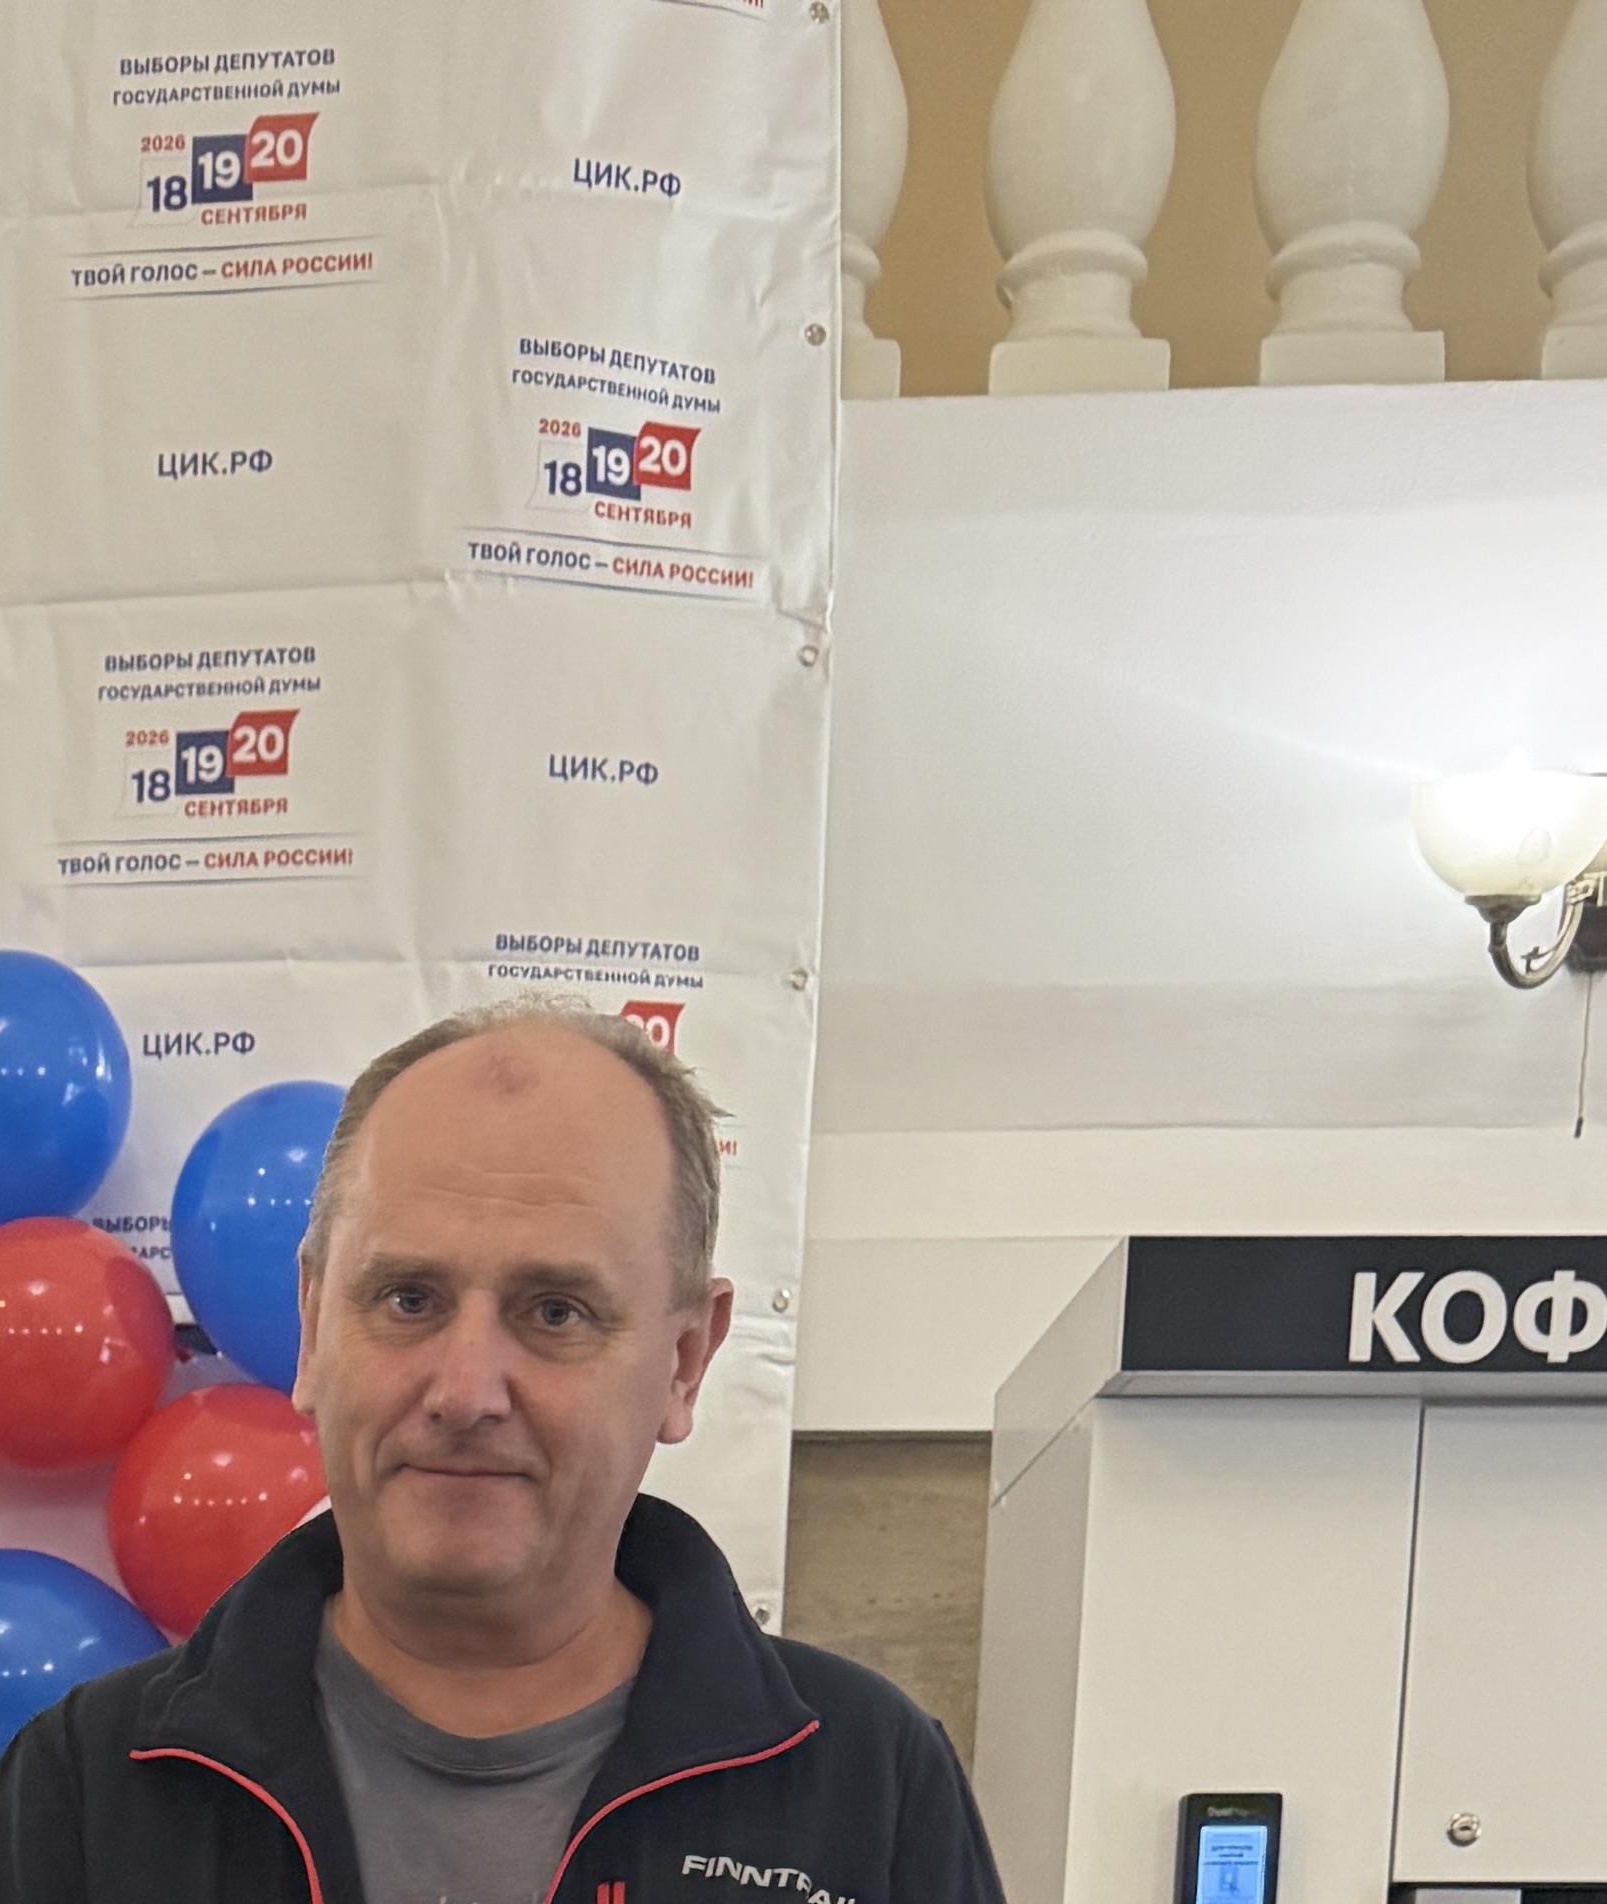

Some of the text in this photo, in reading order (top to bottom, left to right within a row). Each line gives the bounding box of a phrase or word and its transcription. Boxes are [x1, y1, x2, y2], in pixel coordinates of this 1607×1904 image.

[121, 49, 335, 75] ВЫБОРЫ ДЕПУТАТОВ
[113, 80, 340, 105] ГОСУДАРСТВЕННОЙ ДУМЫ
[141, 135, 185, 152] 2026
[147, 130, 303, 212] 18 19 20
[574, 158, 681, 197] ЦИК.РФ
[199, 202, 306, 225] СЕНТЯБРЯ
[72, 264, 125, 286] ТВОЙ
[131, 264, 197, 283] ГОЛОС
[221, 259, 276, 278] СИЛА
[283, 253, 372, 274] РОССИИ!
[520, 338, 715, 386] ВЫБОРЫ ДЕПУТАТОВ
[512, 368, 720, 413] ГОСУДАРСТВЕННОЙ ДУМЫ
[539, 419, 581, 437] 2026
[158, 449, 272, 480] ЦИК.РФ
[544, 436, 687, 497] 18 19 20
[595, 500, 691, 529] СЕНТЯБРЯ
[468, 542, 521, 562] ТВОЙ
[526, 549, 590, 570] ГОЛОС
[613, 557, 664, 578] СИЛА
[669, 563, 753, 587] РОССИИ!
[105, 647, 315, 671] ВЫБОРЫ ДЕПУТАТОВ
[98, 676, 320, 701] ГОСУДАРСТВЕННОЙ ДУМЫ
[126, 730, 169, 747] 2026
[132, 726, 285, 803] 18 19 20
[549, 754, 658, 785] ЦИК.РФ
[185, 798, 288, 817] СЕНТЯБРЯ
[58, 853, 110, 875] ТВОЙ
[116, 854, 181, 872] ГОЛОС
[204, 852, 258, 869] СИЛА
[264, 848, 353, 867] РОССИИ!
[496, 934, 699, 961] ВЫБОРЫ ДЕПУТАТОВ
[489, 964, 703, 988] ГОСУДАРСТВЕННОЙ ДУМЫ
[143, 1032, 255, 1060] ЦИК.РФ
